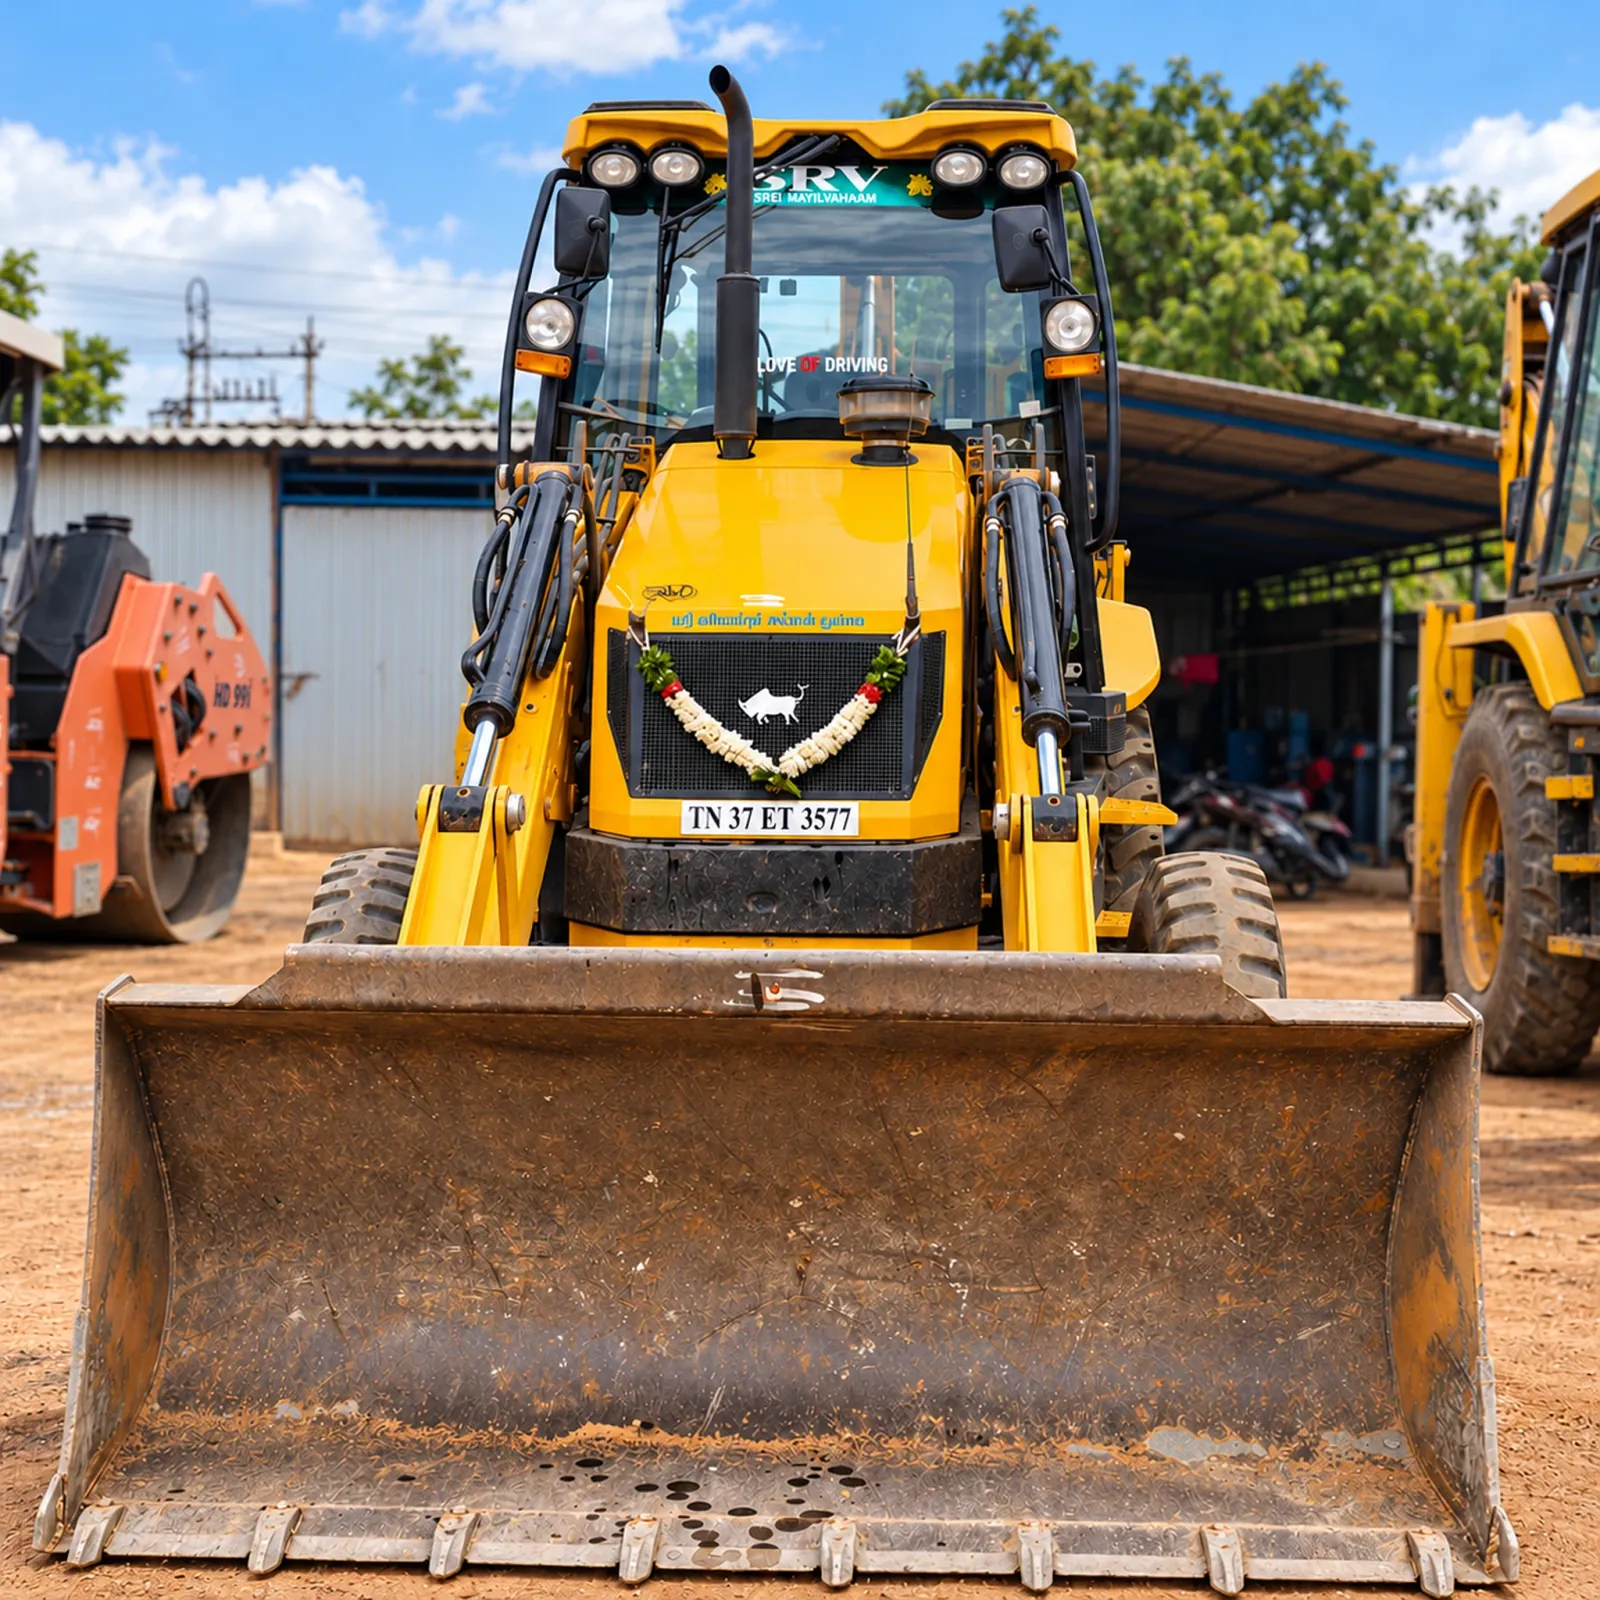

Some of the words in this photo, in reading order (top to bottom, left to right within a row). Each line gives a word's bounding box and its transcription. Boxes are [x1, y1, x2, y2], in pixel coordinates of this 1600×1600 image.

[757, 356, 796, 373] LOVE
[800, 356, 821, 373] OF
[825, 356, 888, 373] DRIVING
[689, 806, 722, 829] TN
[728, 806, 753, 830] 37
[761, 807, 794, 830] ET
[800, 807, 851, 831] 3577
